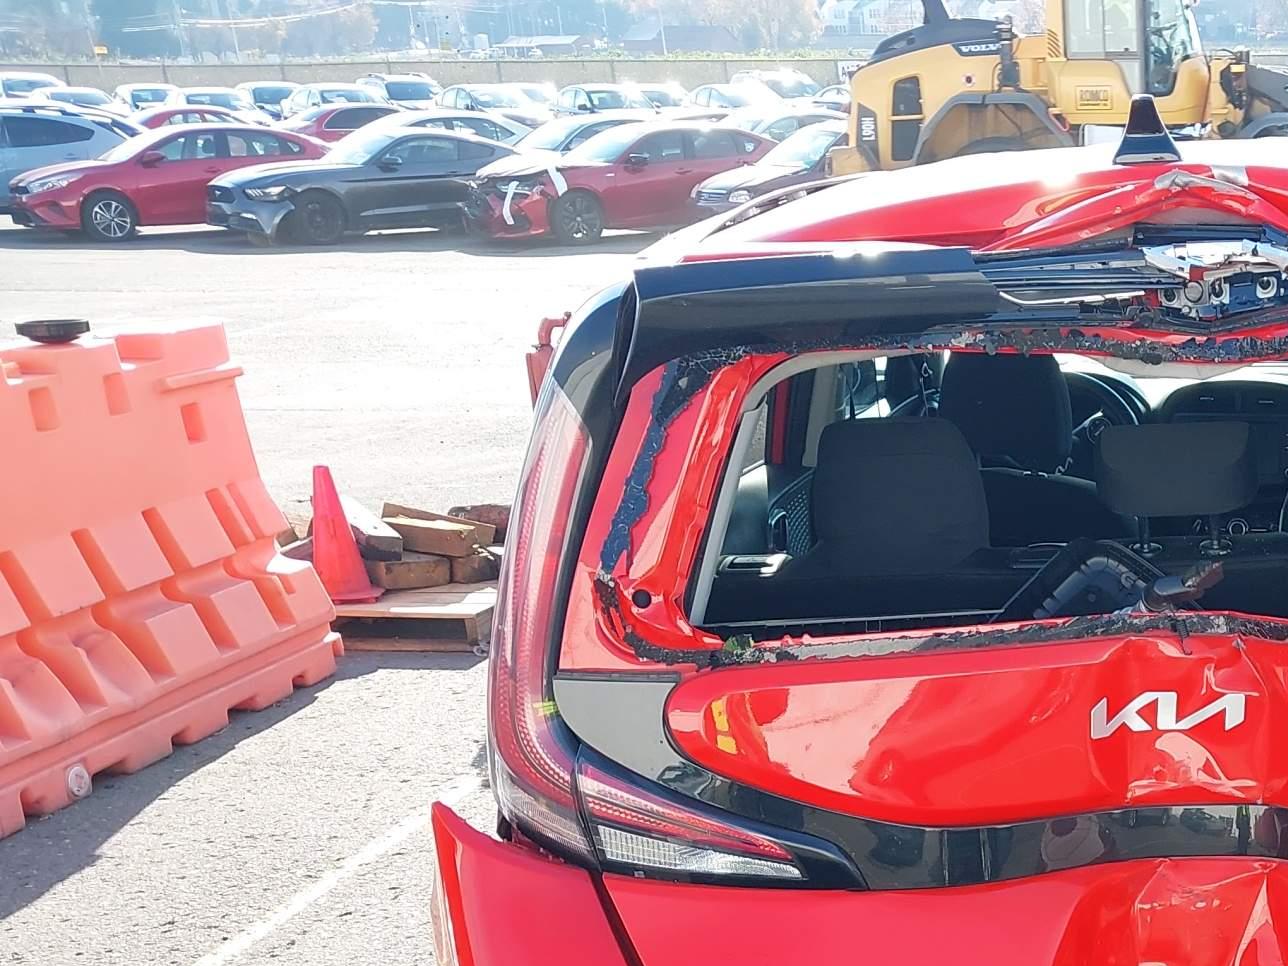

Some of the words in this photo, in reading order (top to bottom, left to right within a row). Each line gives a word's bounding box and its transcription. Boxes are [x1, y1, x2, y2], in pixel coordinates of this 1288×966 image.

[959, 44, 1001, 52] VOLV
[861, 117, 876, 141] L90H
[1091, 691, 1245, 739] KIA
